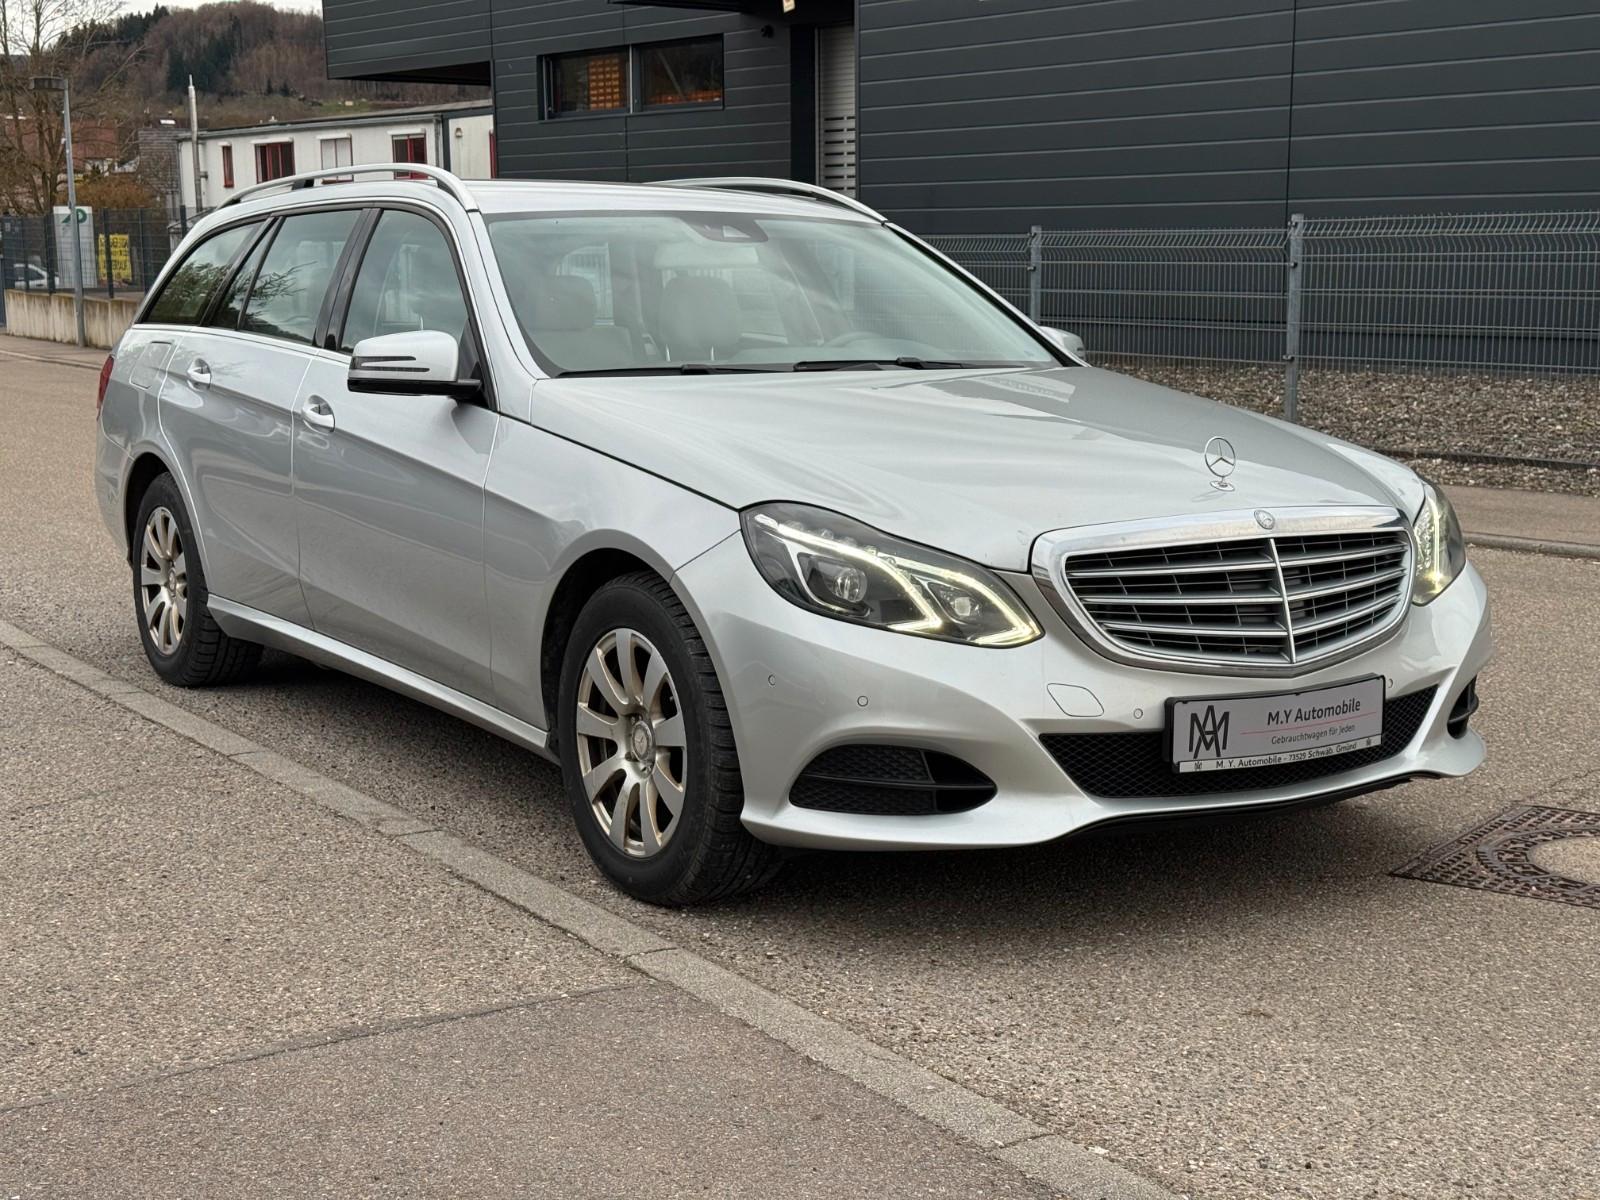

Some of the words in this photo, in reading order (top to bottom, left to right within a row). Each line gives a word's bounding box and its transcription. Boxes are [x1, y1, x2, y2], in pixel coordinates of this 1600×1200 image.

[1294, 697, 1361, 723] Automobile
[1271, 729, 1328, 745] Gebrauchtwagen
[1237, 755, 1282, 769] Automobile
[1289, 752, 1307, 762] 73529
